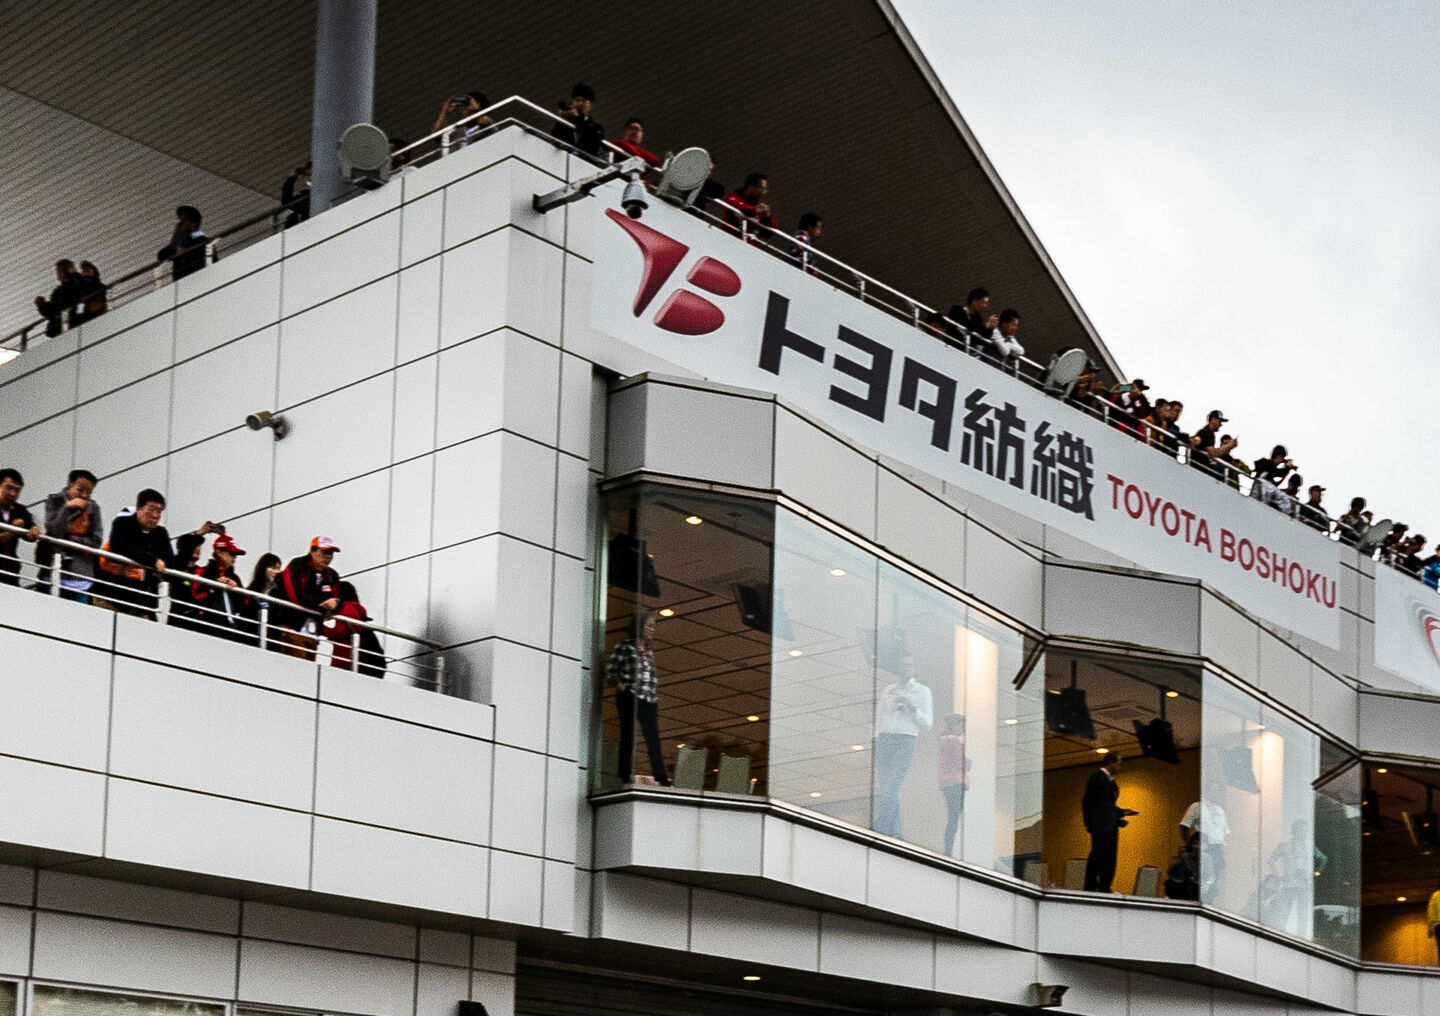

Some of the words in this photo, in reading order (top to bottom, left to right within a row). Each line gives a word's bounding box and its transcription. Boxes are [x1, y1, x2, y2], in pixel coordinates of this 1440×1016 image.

[758, 290, 1095, 521] トヨタ紡織
[1107, 474, 1212, 553] TOYOTA
[1220, 528, 1337, 608] BOSHOKU
